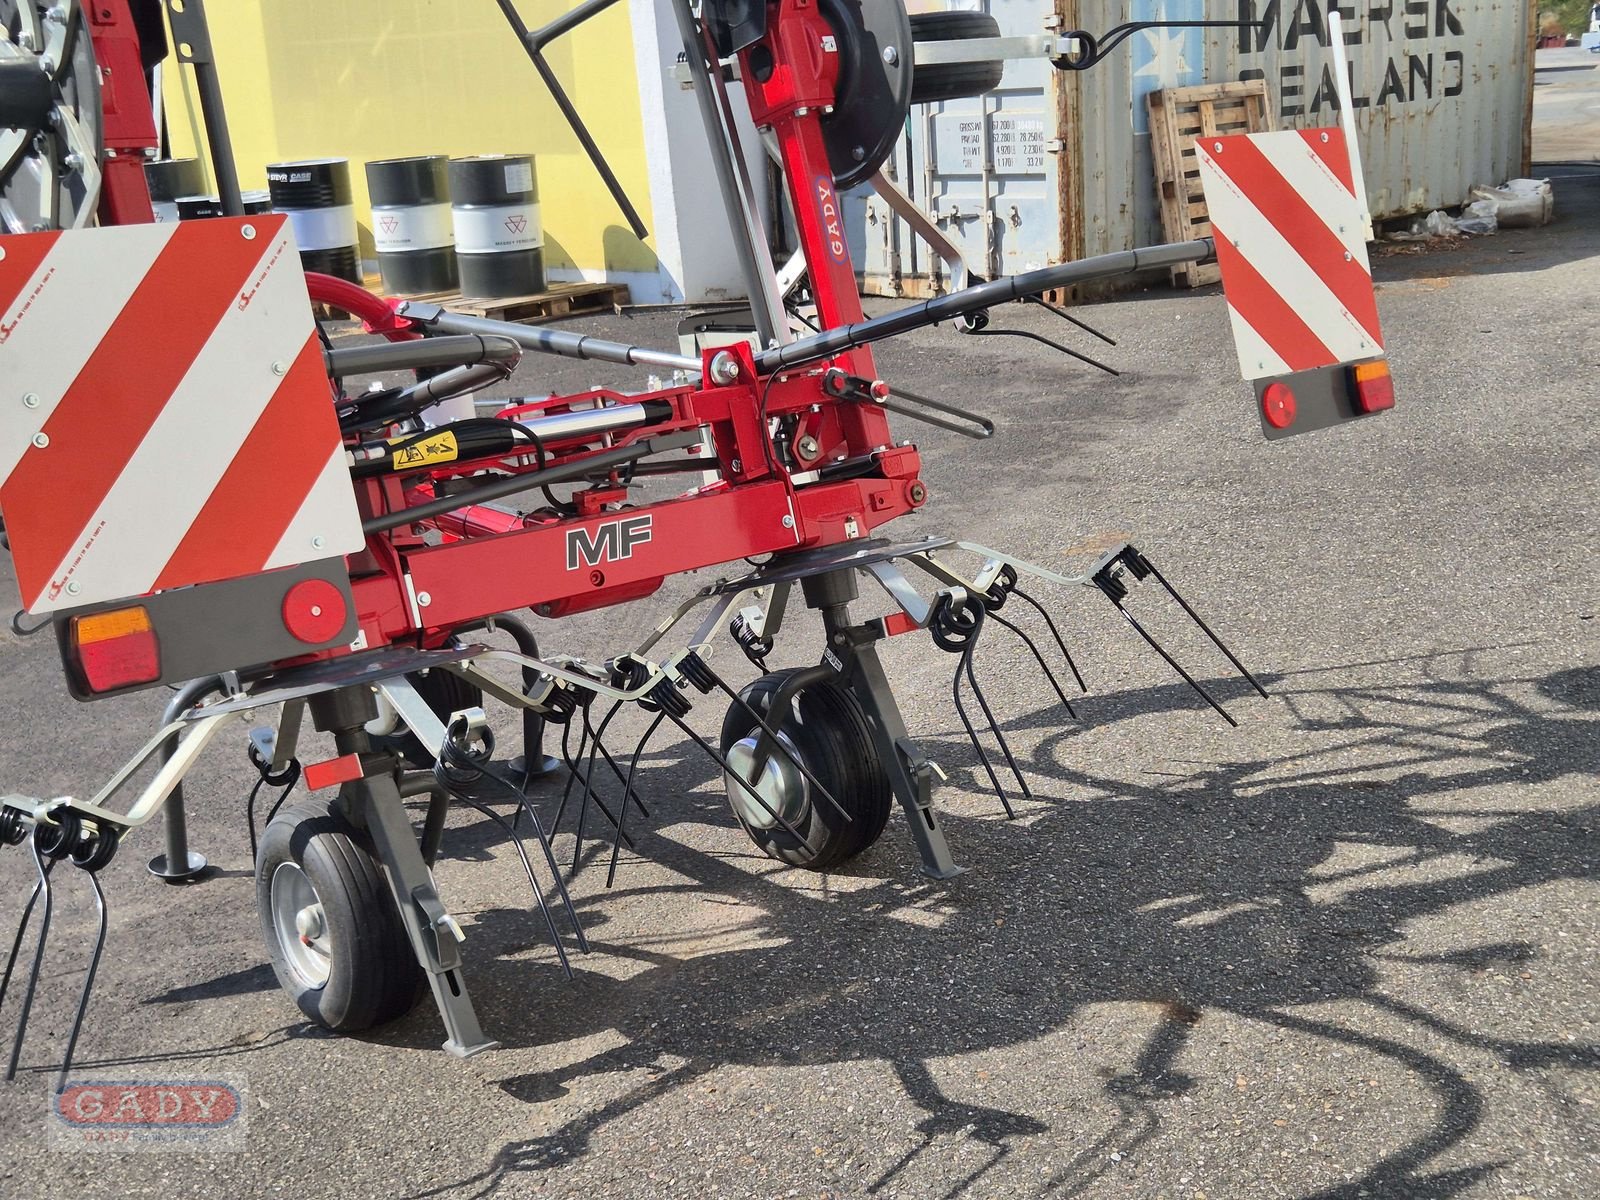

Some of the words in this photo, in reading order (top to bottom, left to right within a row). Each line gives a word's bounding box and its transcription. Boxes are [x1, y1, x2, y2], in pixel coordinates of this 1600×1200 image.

[1239, 0, 1464, 54] MAERSK
[1239, 51, 1464, 118] EALAND
[270, 173, 288, 182] STEYR
[290, 172, 312, 180] CASE
[818, 185, 843, 255] GADY
[565, 514, 652, 571] MF
